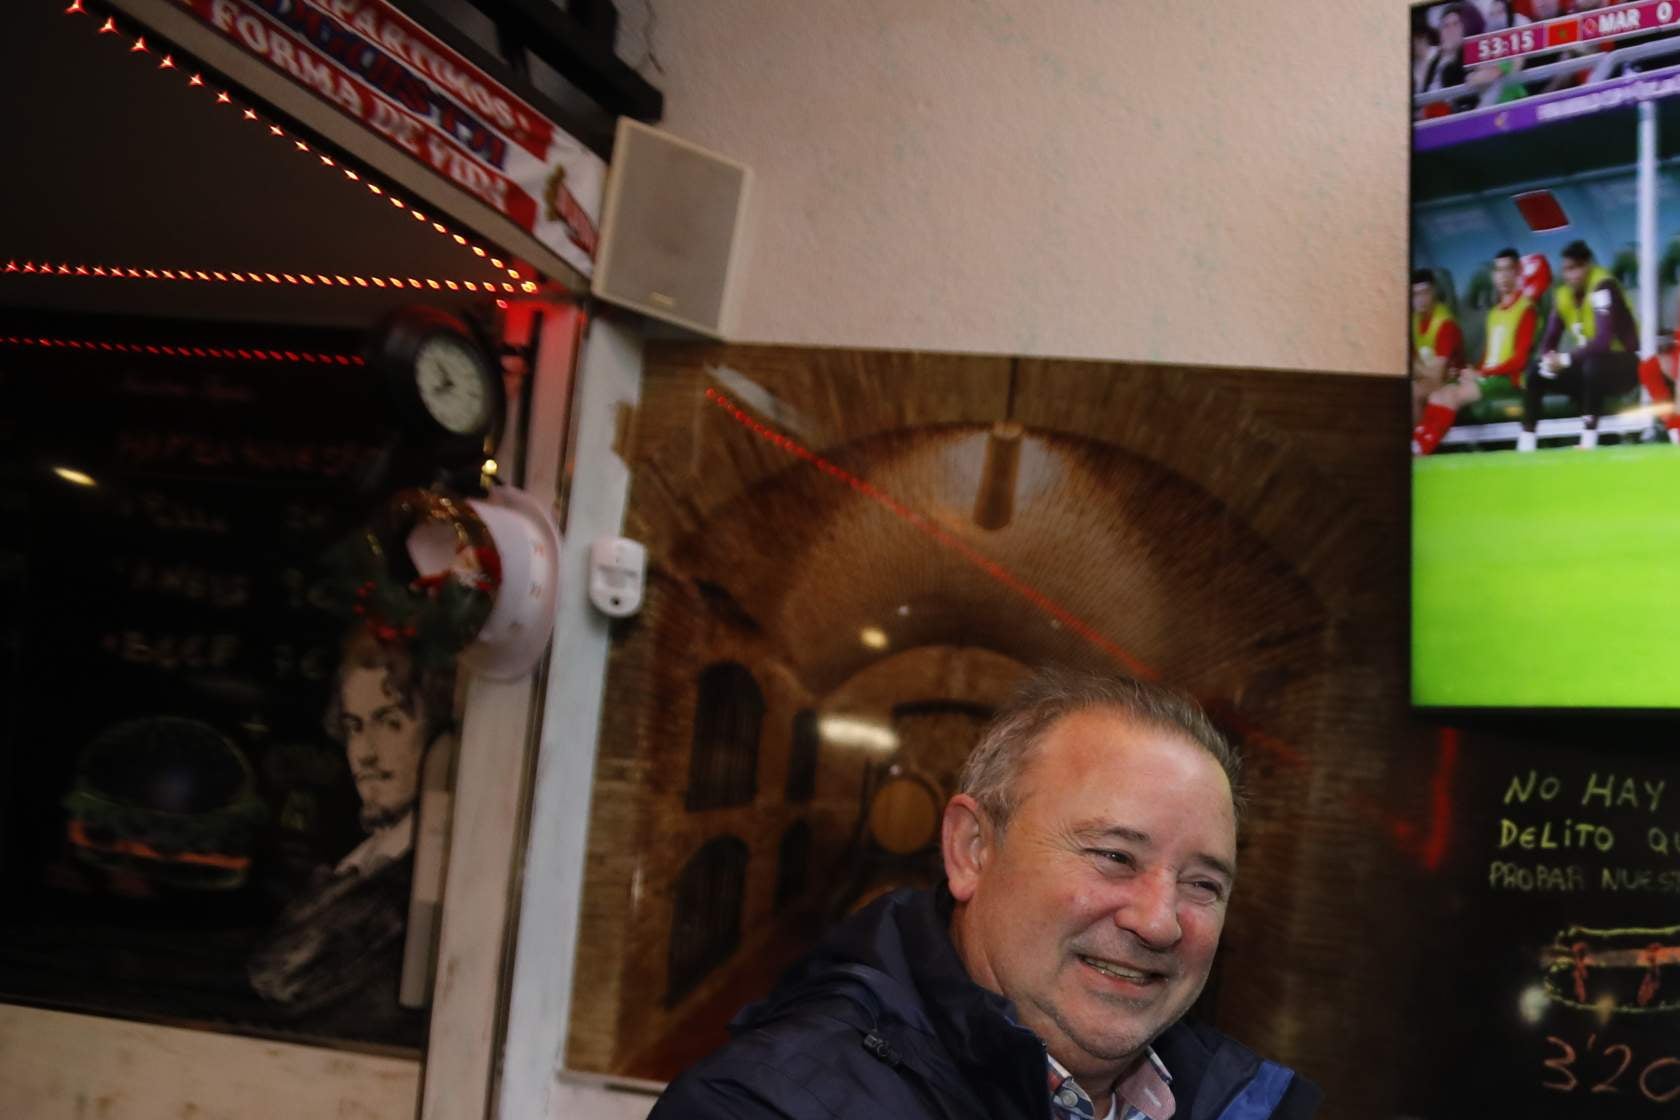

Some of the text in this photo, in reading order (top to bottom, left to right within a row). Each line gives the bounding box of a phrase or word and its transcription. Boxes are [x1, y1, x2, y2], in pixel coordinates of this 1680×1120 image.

[1478, 31, 1534, 58] 53:15
[1598, 8, 1640, 33] MAR
[211, 0, 363, 117] FORMA
[369, 92, 427, 154] DE
[1504, 770, 1560, 804] NO
[1581, 773, 1666, 811] HAY
